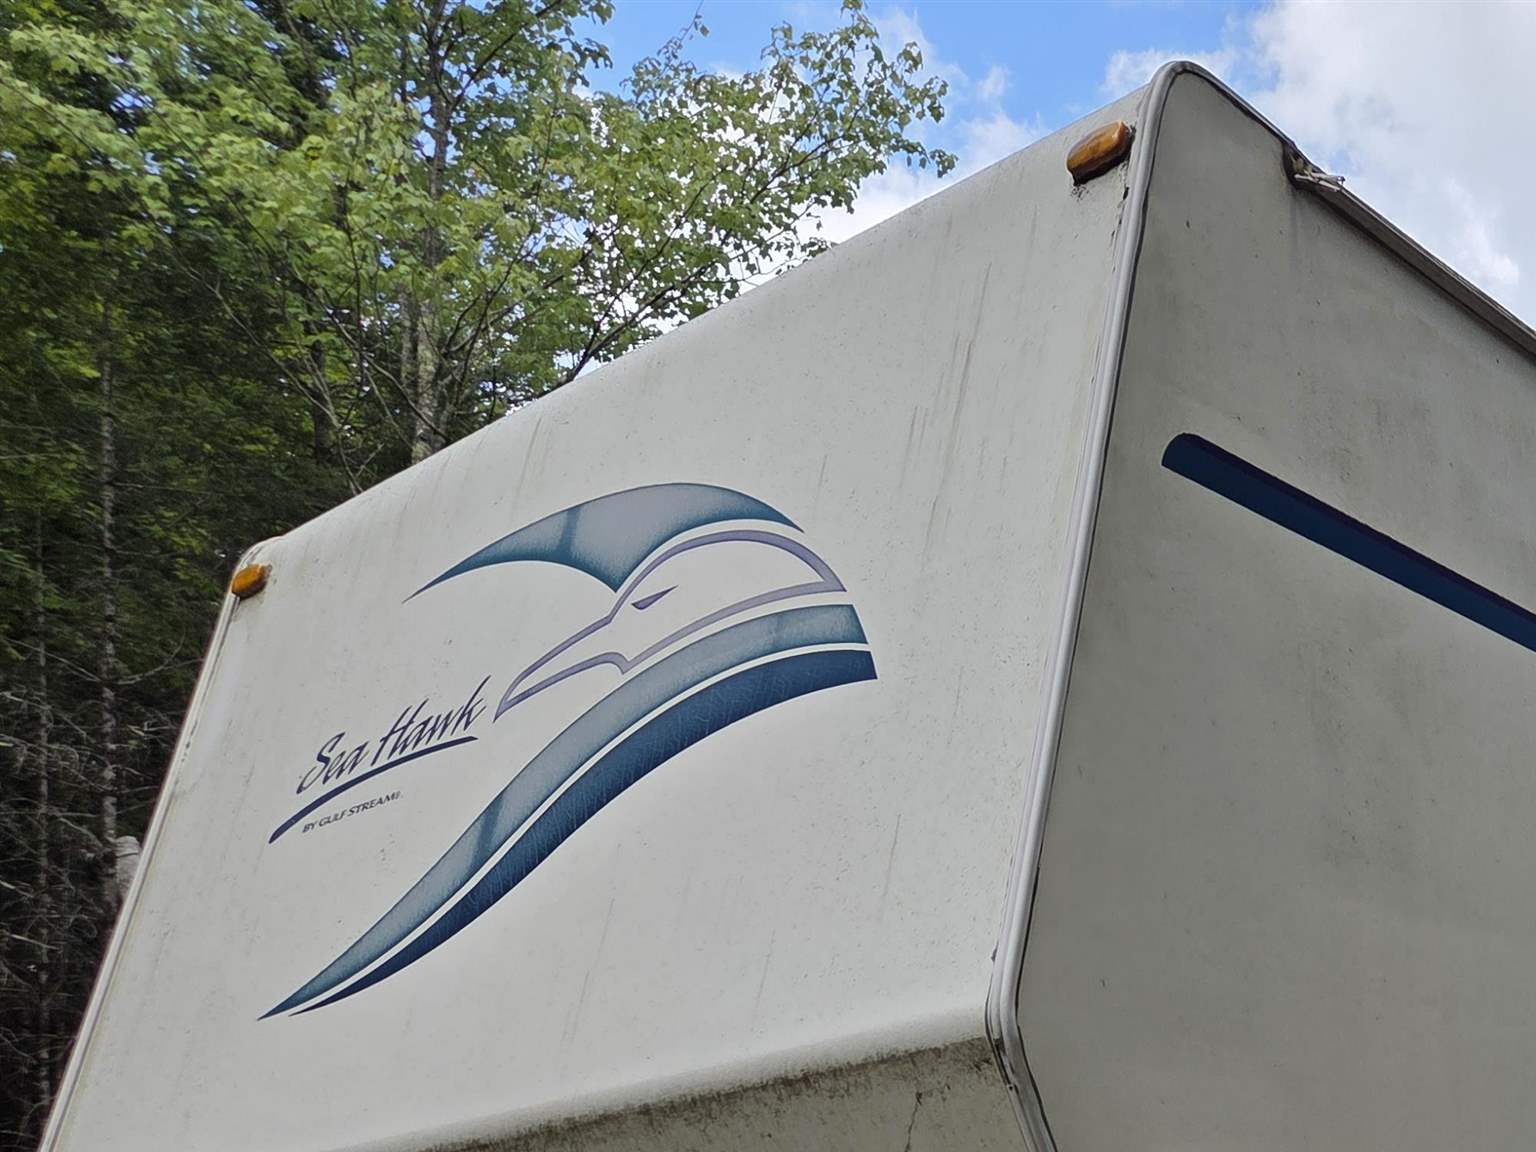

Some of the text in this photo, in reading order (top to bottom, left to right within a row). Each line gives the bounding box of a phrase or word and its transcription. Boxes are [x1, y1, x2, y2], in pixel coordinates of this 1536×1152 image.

[296, 674, 492, 794] Sea Hawk
[302, 821, 317, 833] BY
[319, 809, 346, 827] GULF
